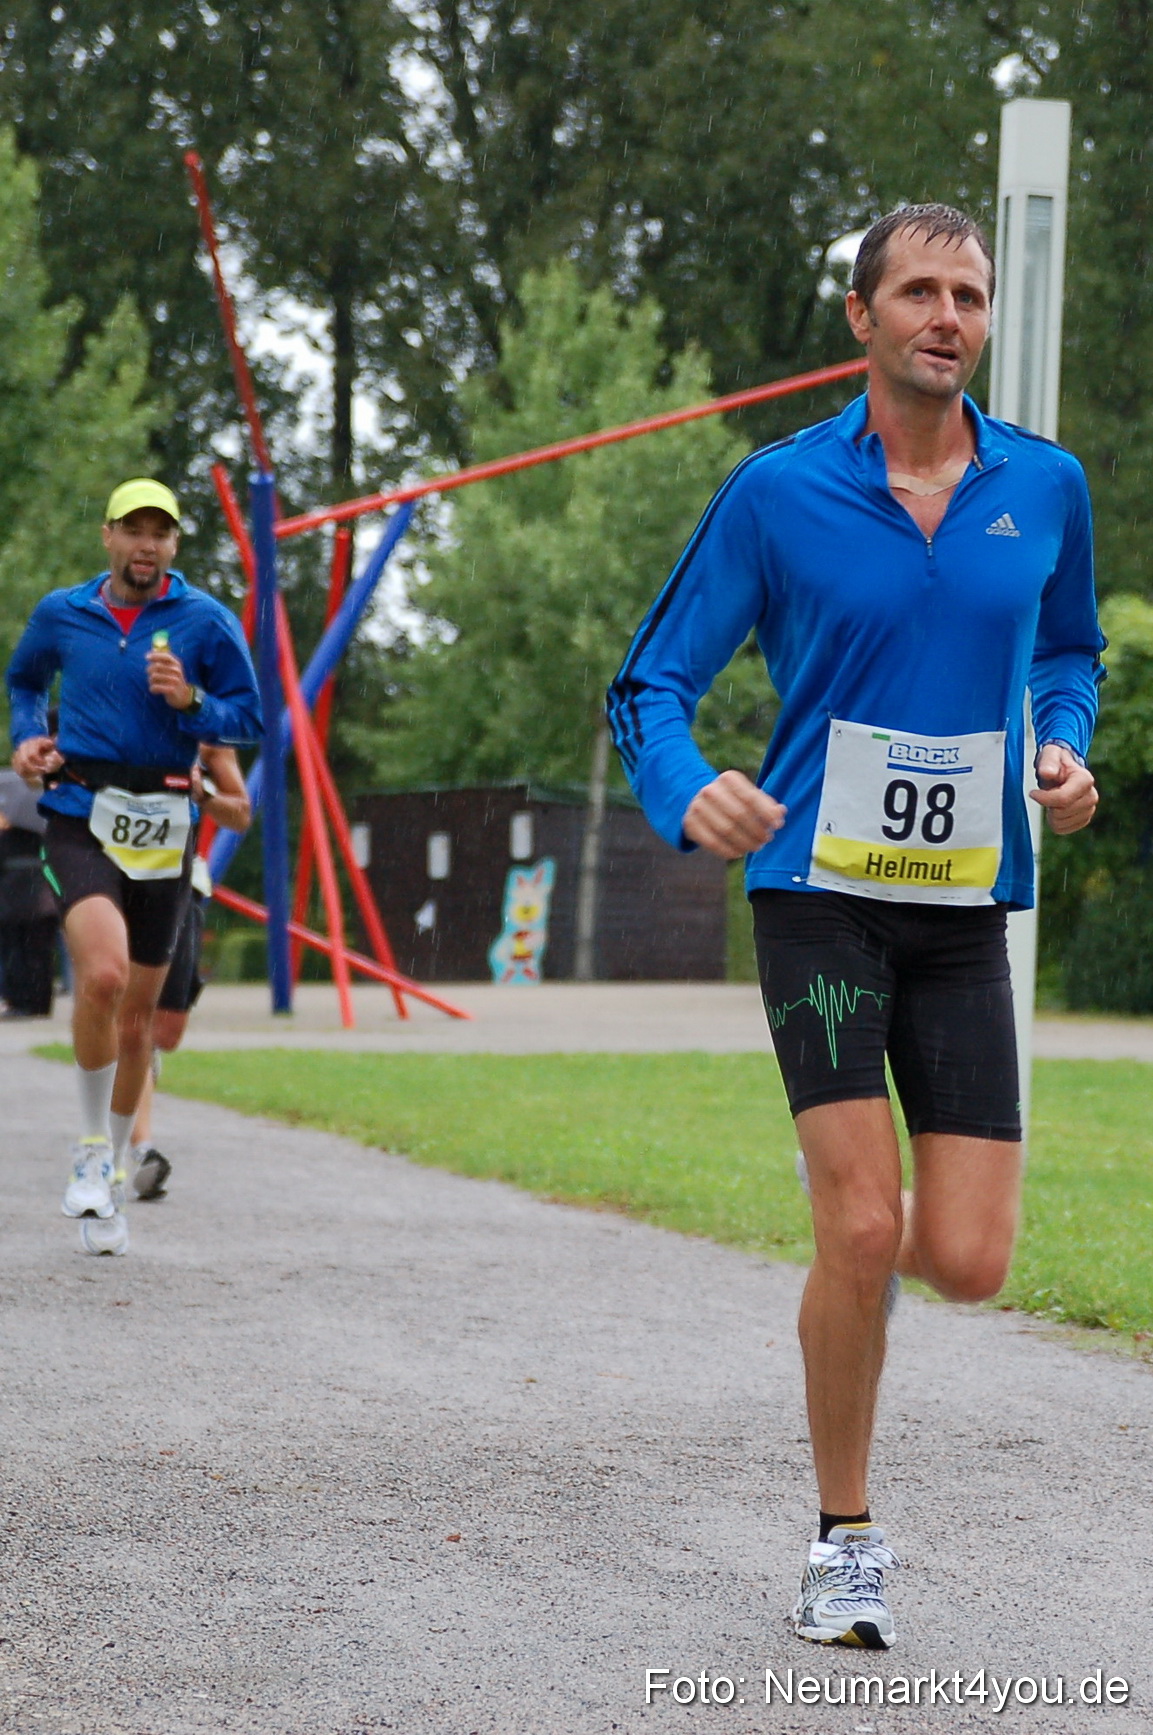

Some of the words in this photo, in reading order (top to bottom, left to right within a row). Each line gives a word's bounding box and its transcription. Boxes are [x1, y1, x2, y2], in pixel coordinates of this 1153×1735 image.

[985, 527, 1021, 537] adidas
[888, 743, 960, 764] BOCK
[881, 779, 956, 843] 98
[112, 814, 170, 847] 824
[865, 852, 953, 881] Helmut
